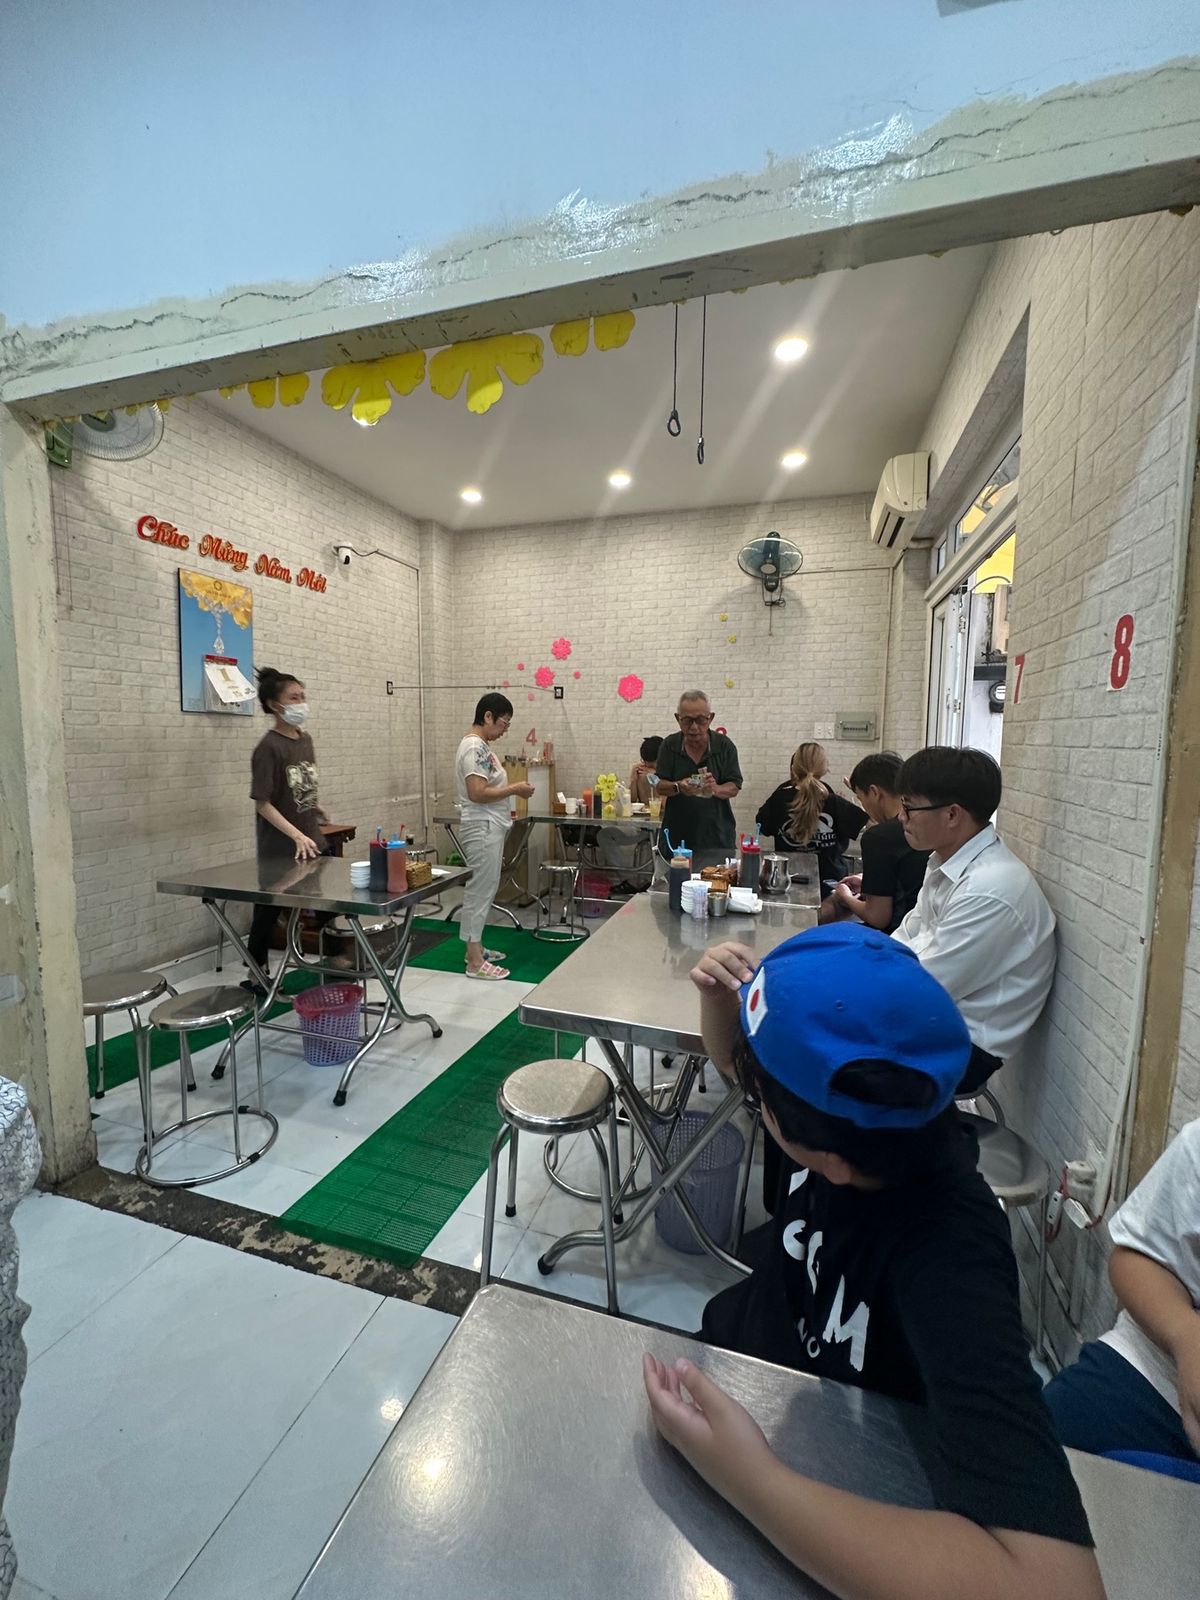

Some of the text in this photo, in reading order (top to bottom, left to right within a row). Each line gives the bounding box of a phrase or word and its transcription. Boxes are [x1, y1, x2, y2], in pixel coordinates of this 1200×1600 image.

[137, 515, 190, 550] Chúc
[254, 554, 292, 584] Năm
[296, 567, 327, 593] Mới
[1013, 654, 1025, 705] 7
[1110, 613, 1134, 690] 8
[525, 727, 538, 747] 4
